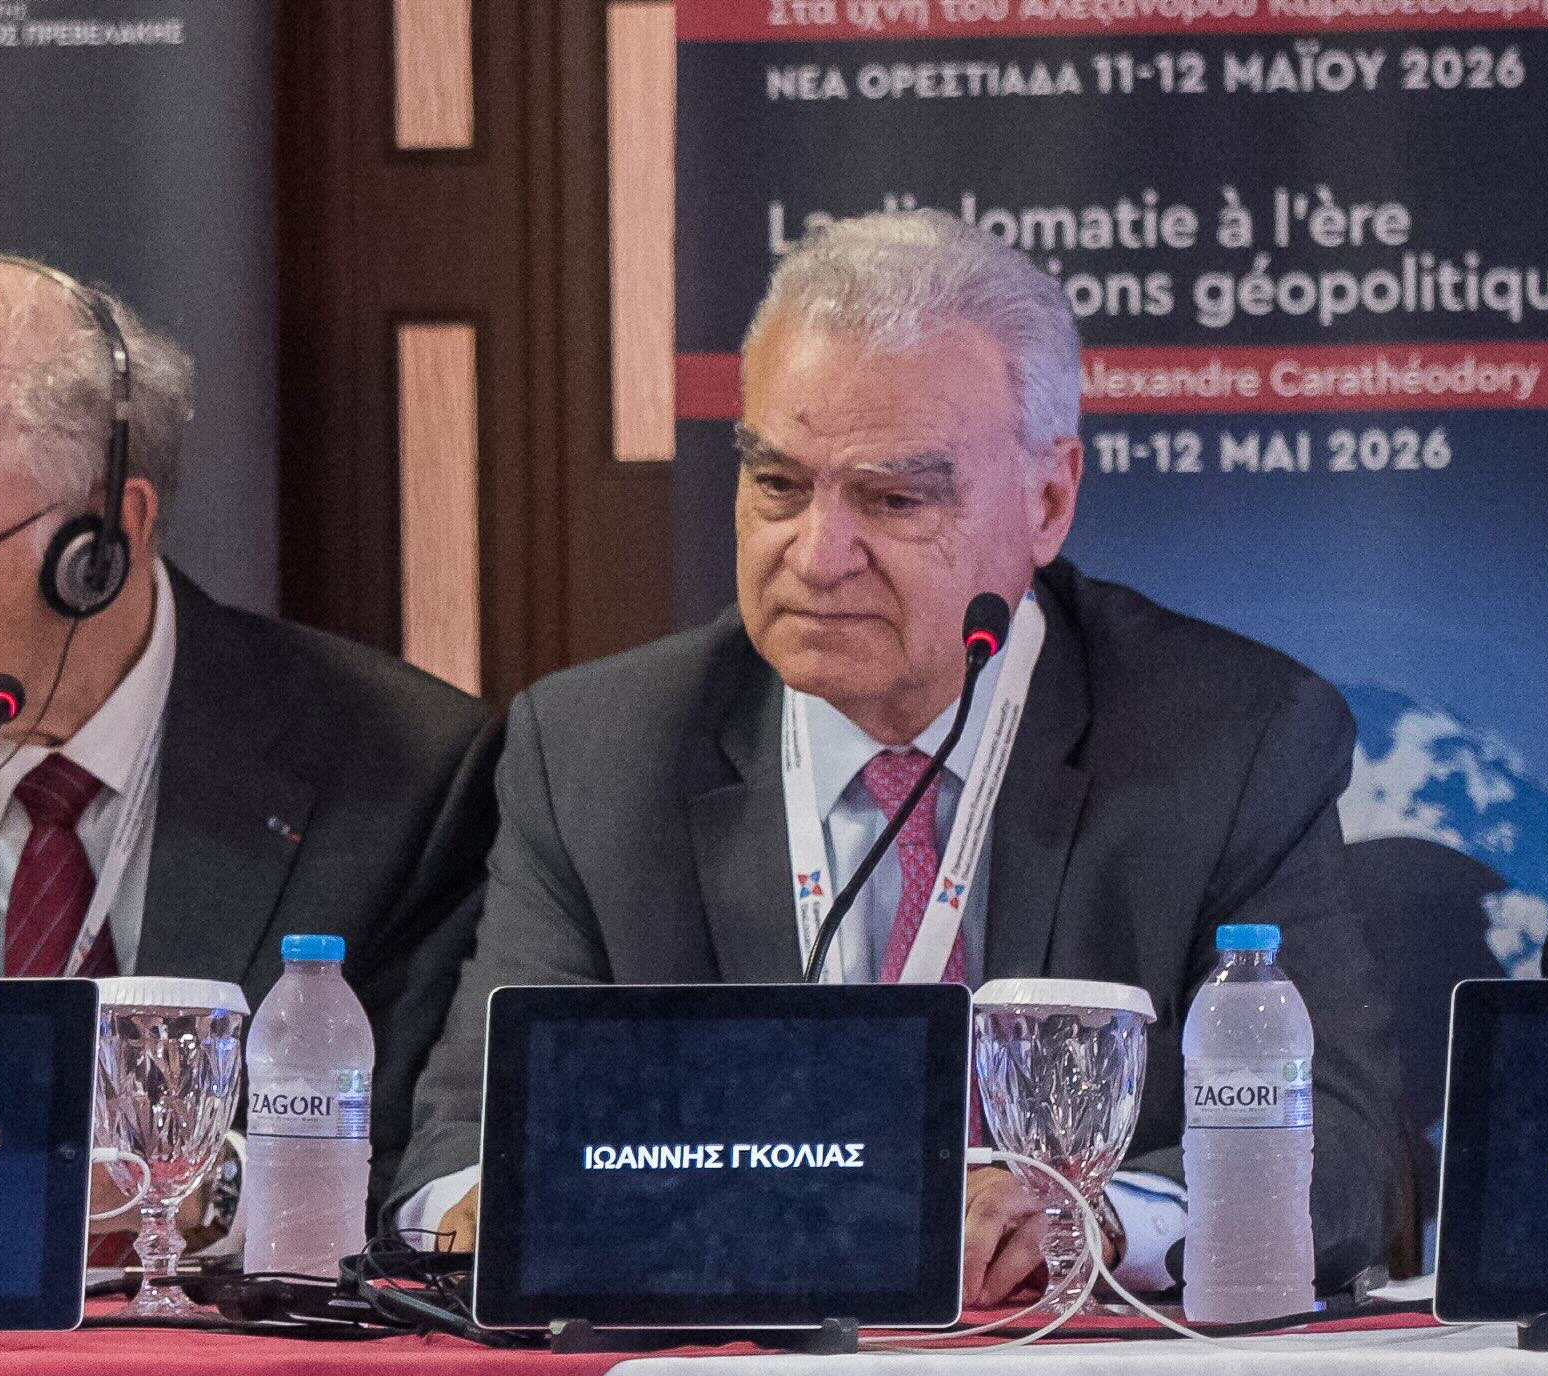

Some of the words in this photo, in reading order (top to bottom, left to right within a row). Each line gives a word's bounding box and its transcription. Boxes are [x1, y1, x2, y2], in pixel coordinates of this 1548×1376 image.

[766, 65, 849, 102] ΝΕΑ
[857, 56, 1084, 101] ΟΡΕΣΤΙΑΔΑ
[1092, 49, 1208, 94] 11-12
[1223, 37, 1387, 93] ΜΑΪΟΥ
[1400, 46, 1527, 91] 2026
[882, 187, 1201, 251] omatie
[1218, 186, 1255, 250] à
[1273, 186, 1413, 249] l'ère
[1270, 352, 1541, 401] Carathéodory
[1092, 429, 1203, 475] 11-12
[1219, 429, 1311, 474] MAI
[1327, 426, 1453, 473] 2026
[251, 1092, 332, 1117] ZAGORI
[1193, 1085, 1278, 1107] ZAGORI
[584, 1143, 724, 1171] ΙΩΑΝΝΗΣ
[730, 1142, 865, 1169] ΓΚΟΛΙΑΣ
